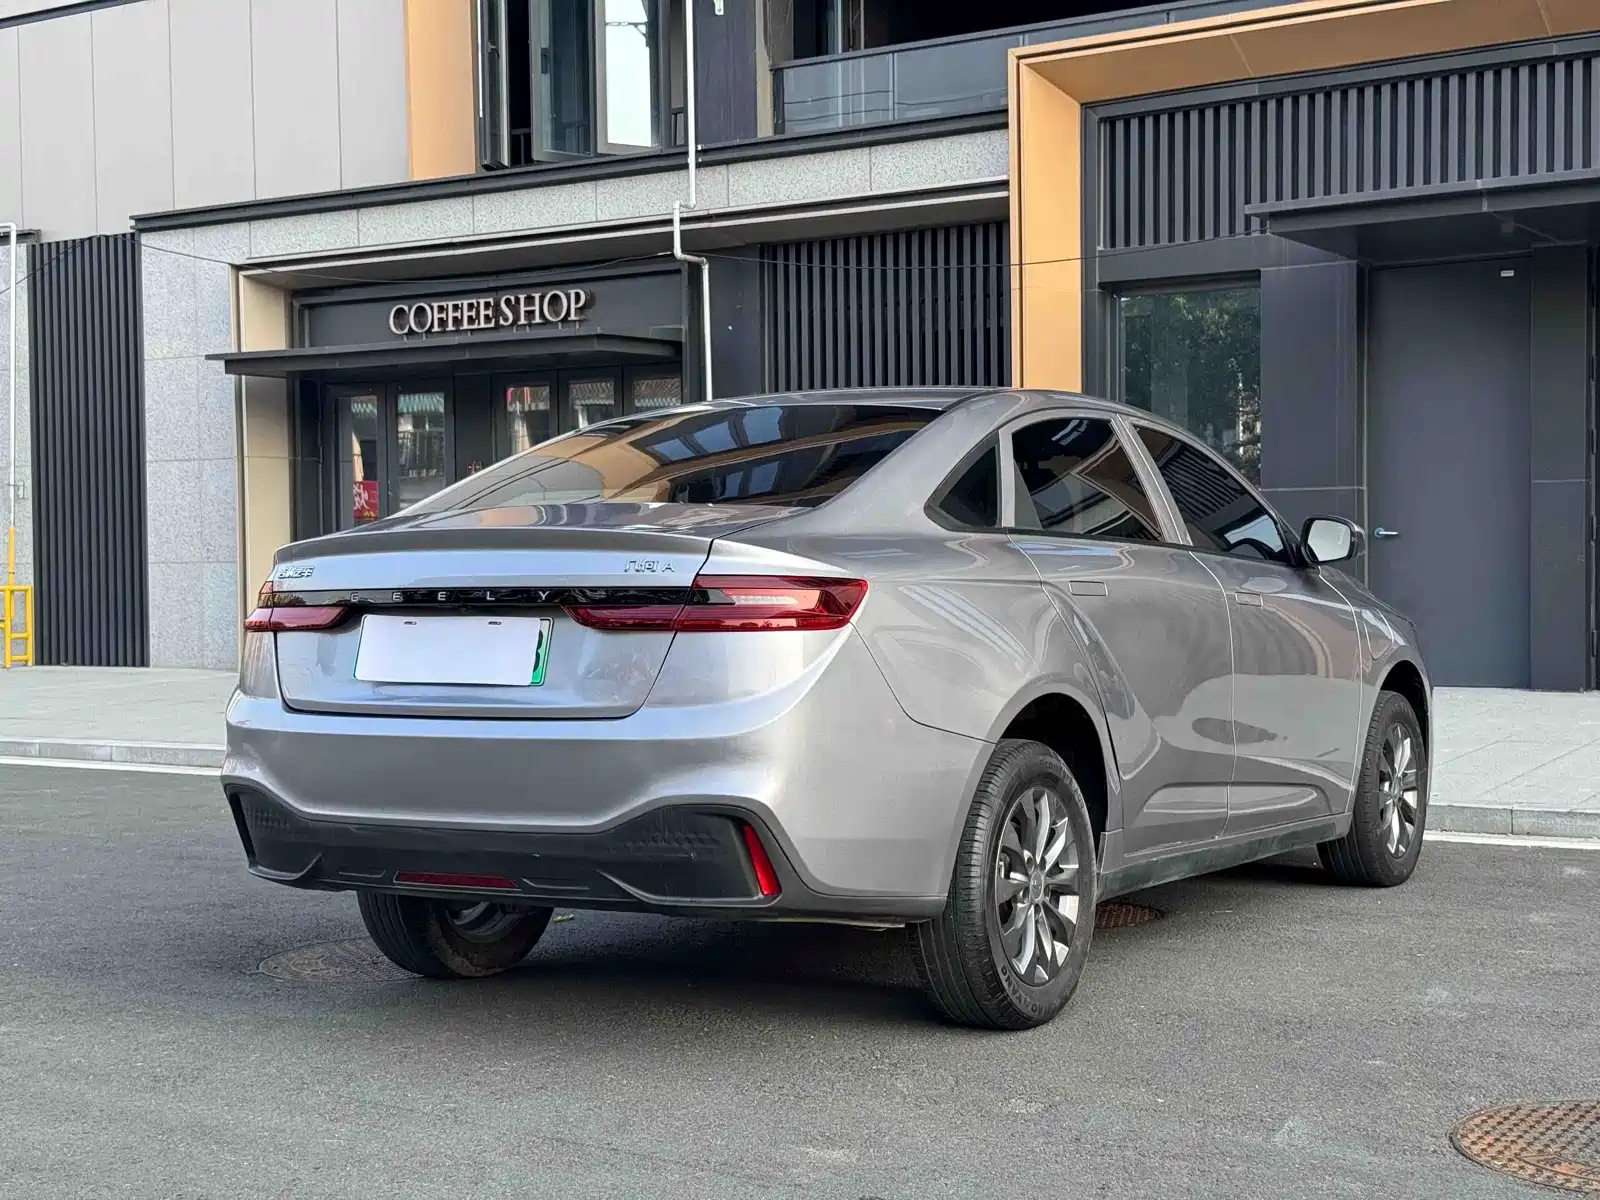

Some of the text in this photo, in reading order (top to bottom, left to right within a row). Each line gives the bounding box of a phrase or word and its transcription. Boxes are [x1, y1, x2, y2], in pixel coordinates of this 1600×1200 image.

[389, 288, 586, 335] COFFEE SHOP
[661, 559, 676, 573] A
[350, 590, 551, 603] GEELY
